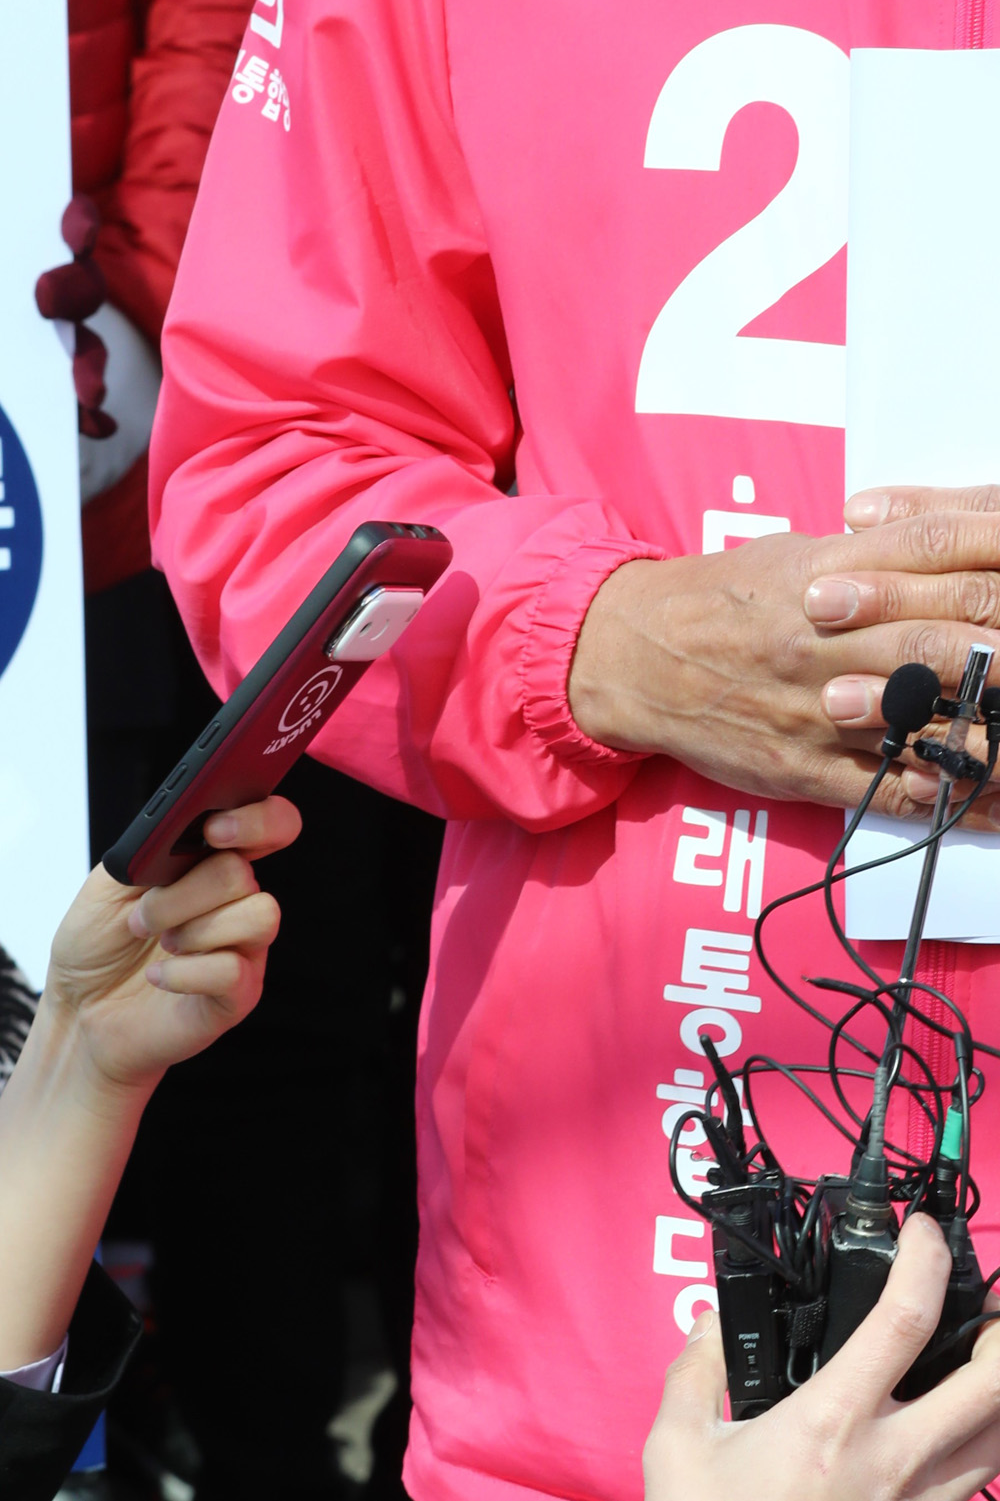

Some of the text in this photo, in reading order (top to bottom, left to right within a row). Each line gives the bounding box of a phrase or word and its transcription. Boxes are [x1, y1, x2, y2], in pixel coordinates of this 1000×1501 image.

[634, 23, 850, 428] 2
[263, 709, 322, 755] LUCKY!
[738, 1332, 760, 1341] POWER
[743, 1342, 757, 1350] ON
[744, 1379, 761, 1388] OFF
